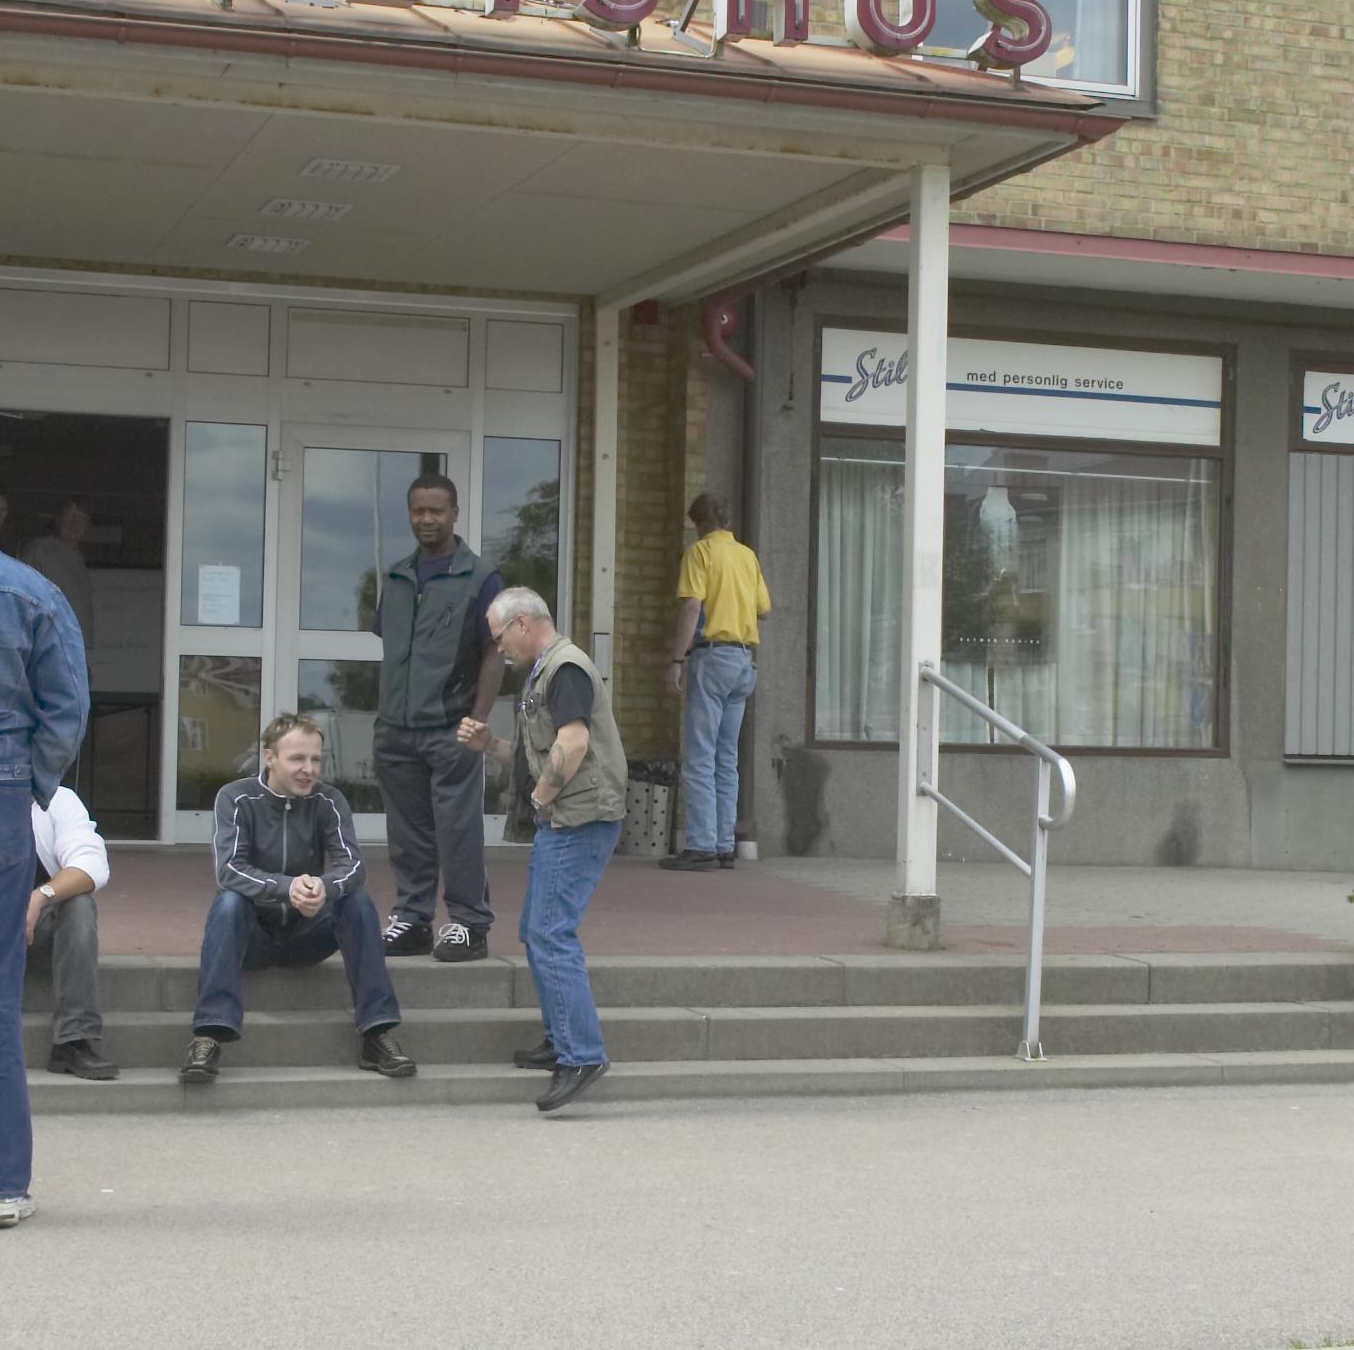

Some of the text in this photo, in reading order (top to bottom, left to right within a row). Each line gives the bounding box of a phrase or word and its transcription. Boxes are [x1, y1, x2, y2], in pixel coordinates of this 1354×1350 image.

[845, 347, 909, 402] Stil
[966, 371, 1125, 390] med personlig service
